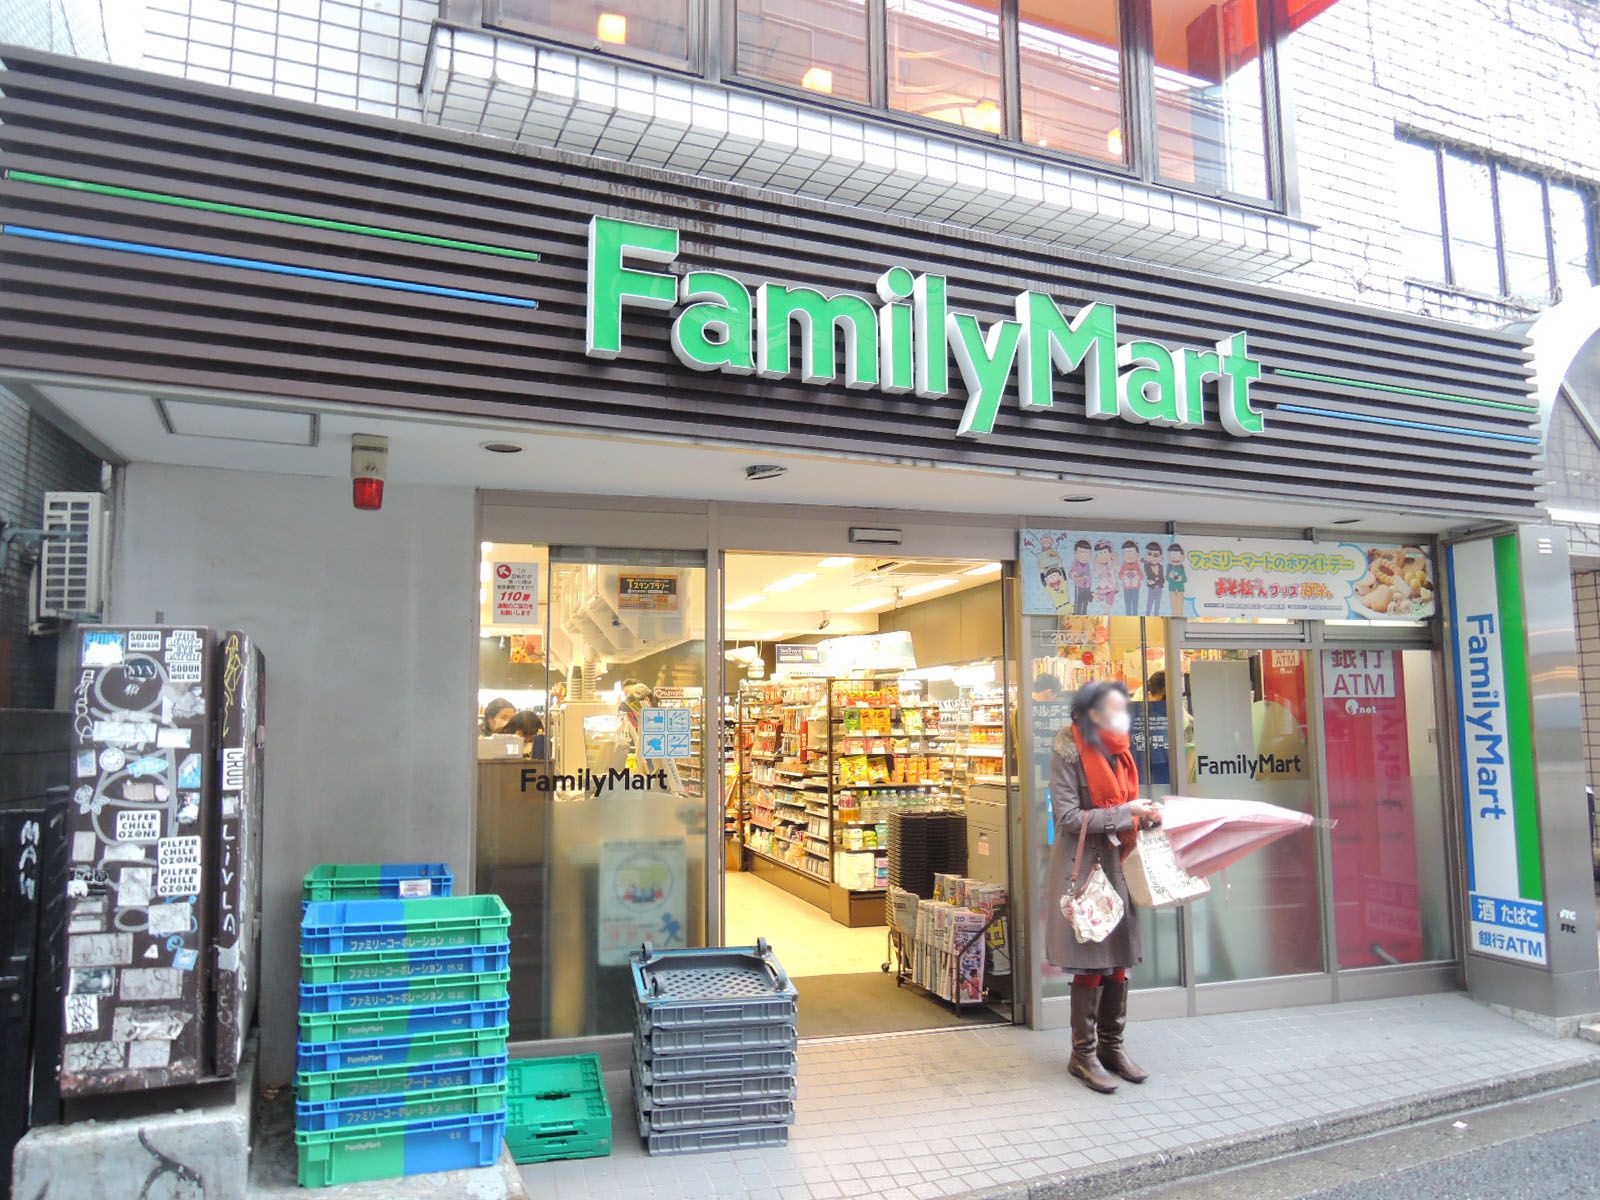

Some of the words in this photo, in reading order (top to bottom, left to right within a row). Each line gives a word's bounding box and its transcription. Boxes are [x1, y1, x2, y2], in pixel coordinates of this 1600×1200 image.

[585, 214, 1267, 439] FamilyMart
[1333, 674, 1385, 695] ATM
[1464, 613, 1507, 820] FamilyMart
[1197, 753, 1301, 779] FamilyMart
[520, 768, 668, 797] FamilyMart
[120, 813, 157, 821] PILFER
[122, 822, 153, 830] CHILE
[118, 830, 157, 838] OZONE
[160, 839, 198, 848] PILFER
[163, 848, 194, 856] CHILE
[160, 856, 198, 865] OZONE
[161, 868, 198, 876] PILFER
[160, 885, 197, 893] OZONE
[1478, 898, 1496, 922] 酒
[1501, 904, 1538, 928] たばこ
[350, 937, 444, 951] ファミリーコーポレーション
[1478, 930, 1542, 957] 銀行ATM
[349, 963, 443, 979] ファミリーコーポレーション
[349, 991, 444, 1007] ファミリーコーポレーション
